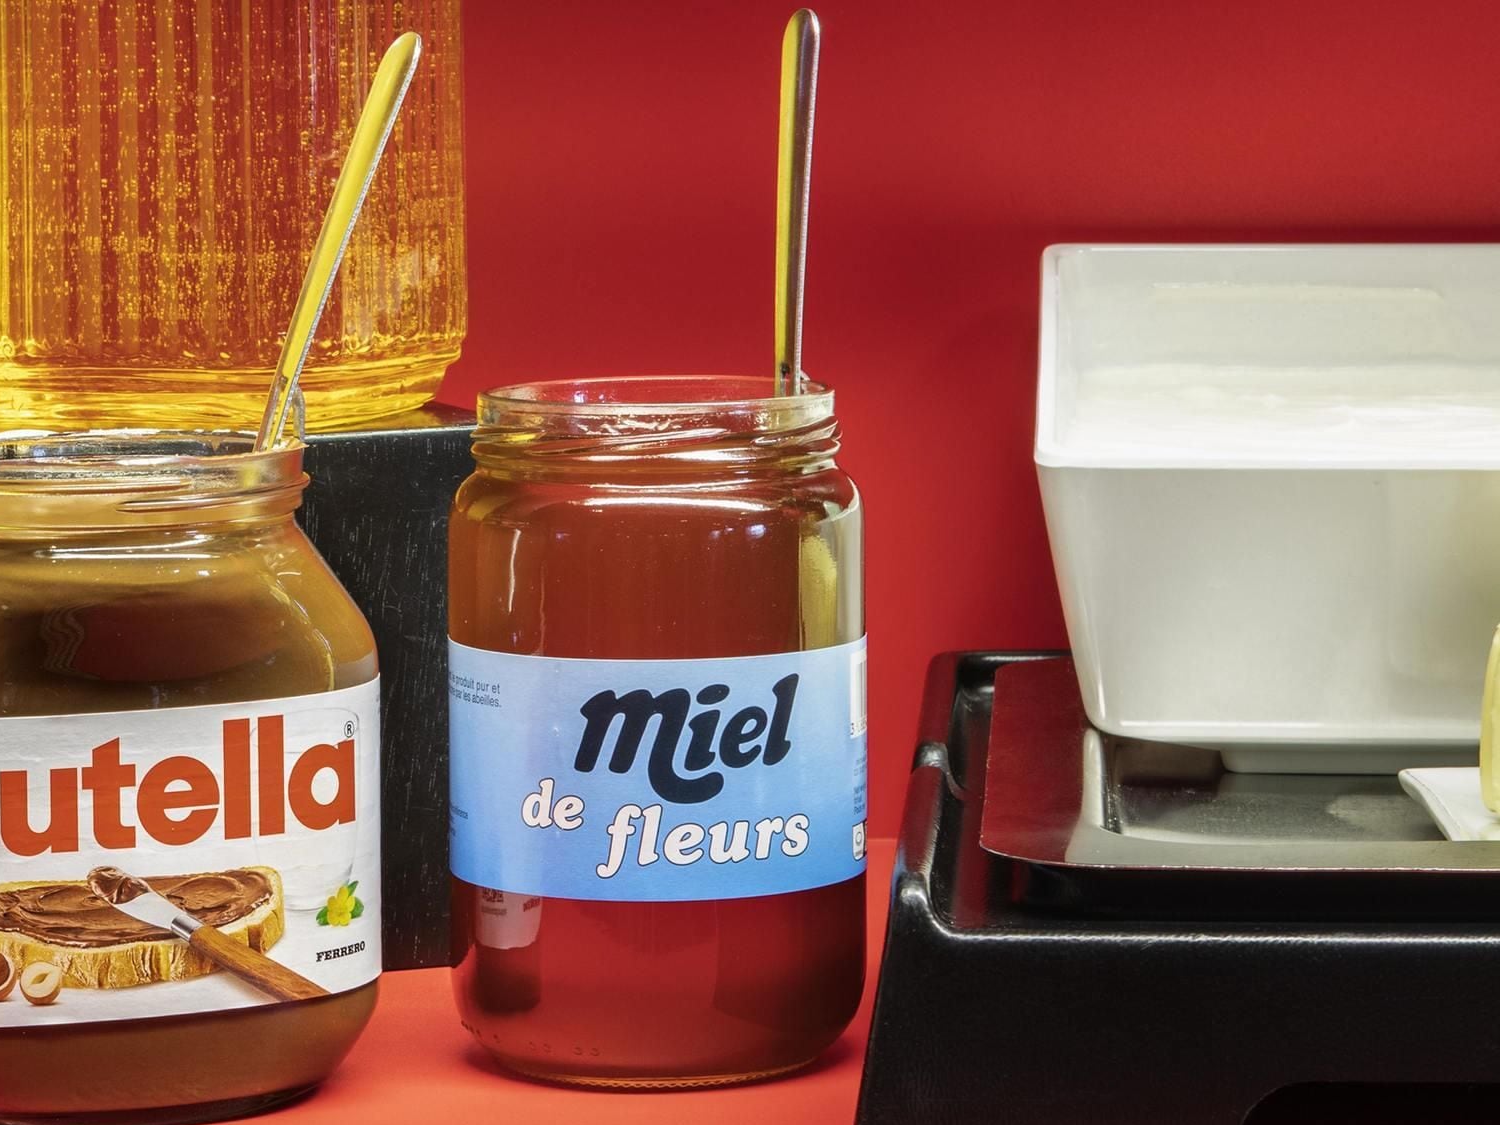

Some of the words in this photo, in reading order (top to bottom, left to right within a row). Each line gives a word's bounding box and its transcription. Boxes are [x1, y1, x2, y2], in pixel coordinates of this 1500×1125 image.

[492, 683, 501, 695] et
[521, 777, 585, 831] de
[596, 804, 810, 879] fleurs
[316, 940, 365, 962] FERRERO
